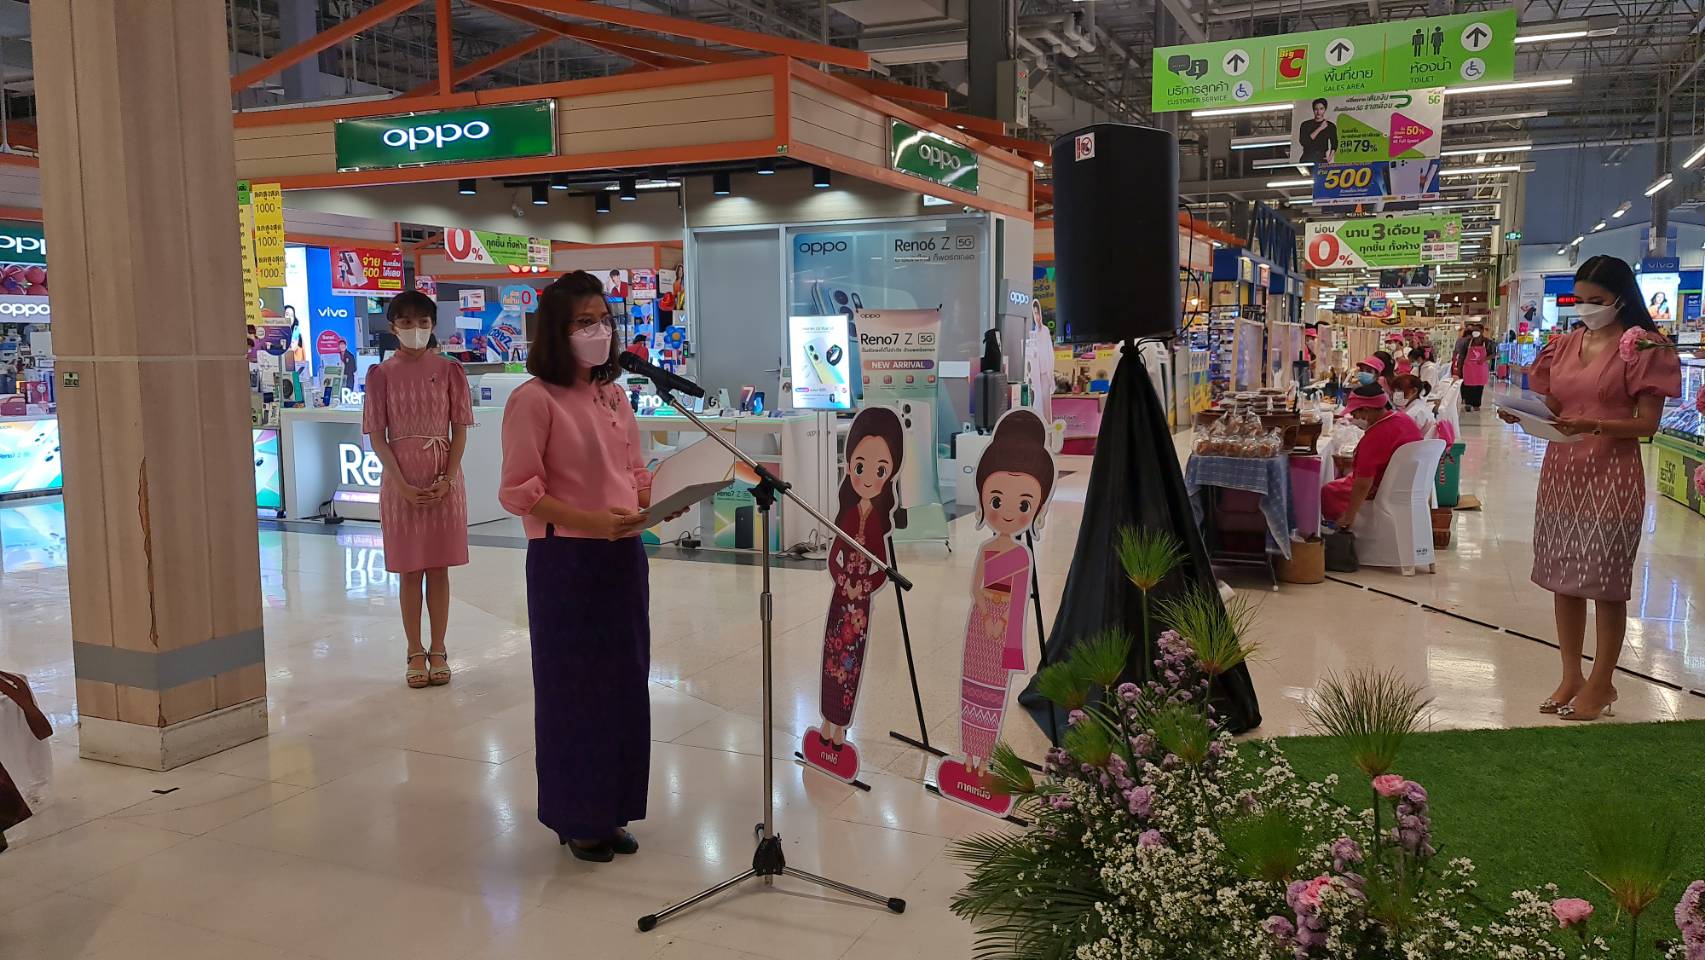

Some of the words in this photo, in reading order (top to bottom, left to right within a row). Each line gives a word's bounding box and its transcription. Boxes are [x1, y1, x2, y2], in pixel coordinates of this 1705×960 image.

[1410, 57, 1451, 74] ห้องน้ำ
[1324, 67, 1374, 82] พื้นที่ขาย
[1410, 76, 1434, 84] TOILET
[1167, 80, 1229, 97] บริการลูกค้า
[1323, 85, 1345, 93] SALES
[1346, 82, 1365, 91] AREA
[1167, 97, 1200, 106] CUSTOMER
[1201, 94, 1227, 104] SERVICE
[1428, 95, 1440, 105] 5G
[383, 120, 490, 150] oppo
[919, 144, 961, 170] oppo
[1324, 167, 1372, 189] 500
[1314, 224, 1335, 234] ผ่อน
[1345, 229, 1369, 238] นาน
[1371, 223, 1386, 241] 3
[1387, 223, 1421, 237] เดือน
[894, 237, 936, 252] Reno6
[941, 236, 950, 250] Z
[957, 238, 972, 247] 5G
[1359, 242, 1386, 255] ทุกชิ้น
[1388, 240, 1421, 251] ทั้งห้าง
[362, 253, 381, 267] จ่าย
[1010, 291, 1029, 305] oppo
[0, 303, 50, 317] oppo
[318, 307, 348, 318] vivo
[860, 333, 899, 345] Reno7
[904, 333, 913, 345] Z
[920, 335, 933, 343] 5G
[871, 361, 890, 369] NEW
[892, 361, 925, 369] ARRIVAL
